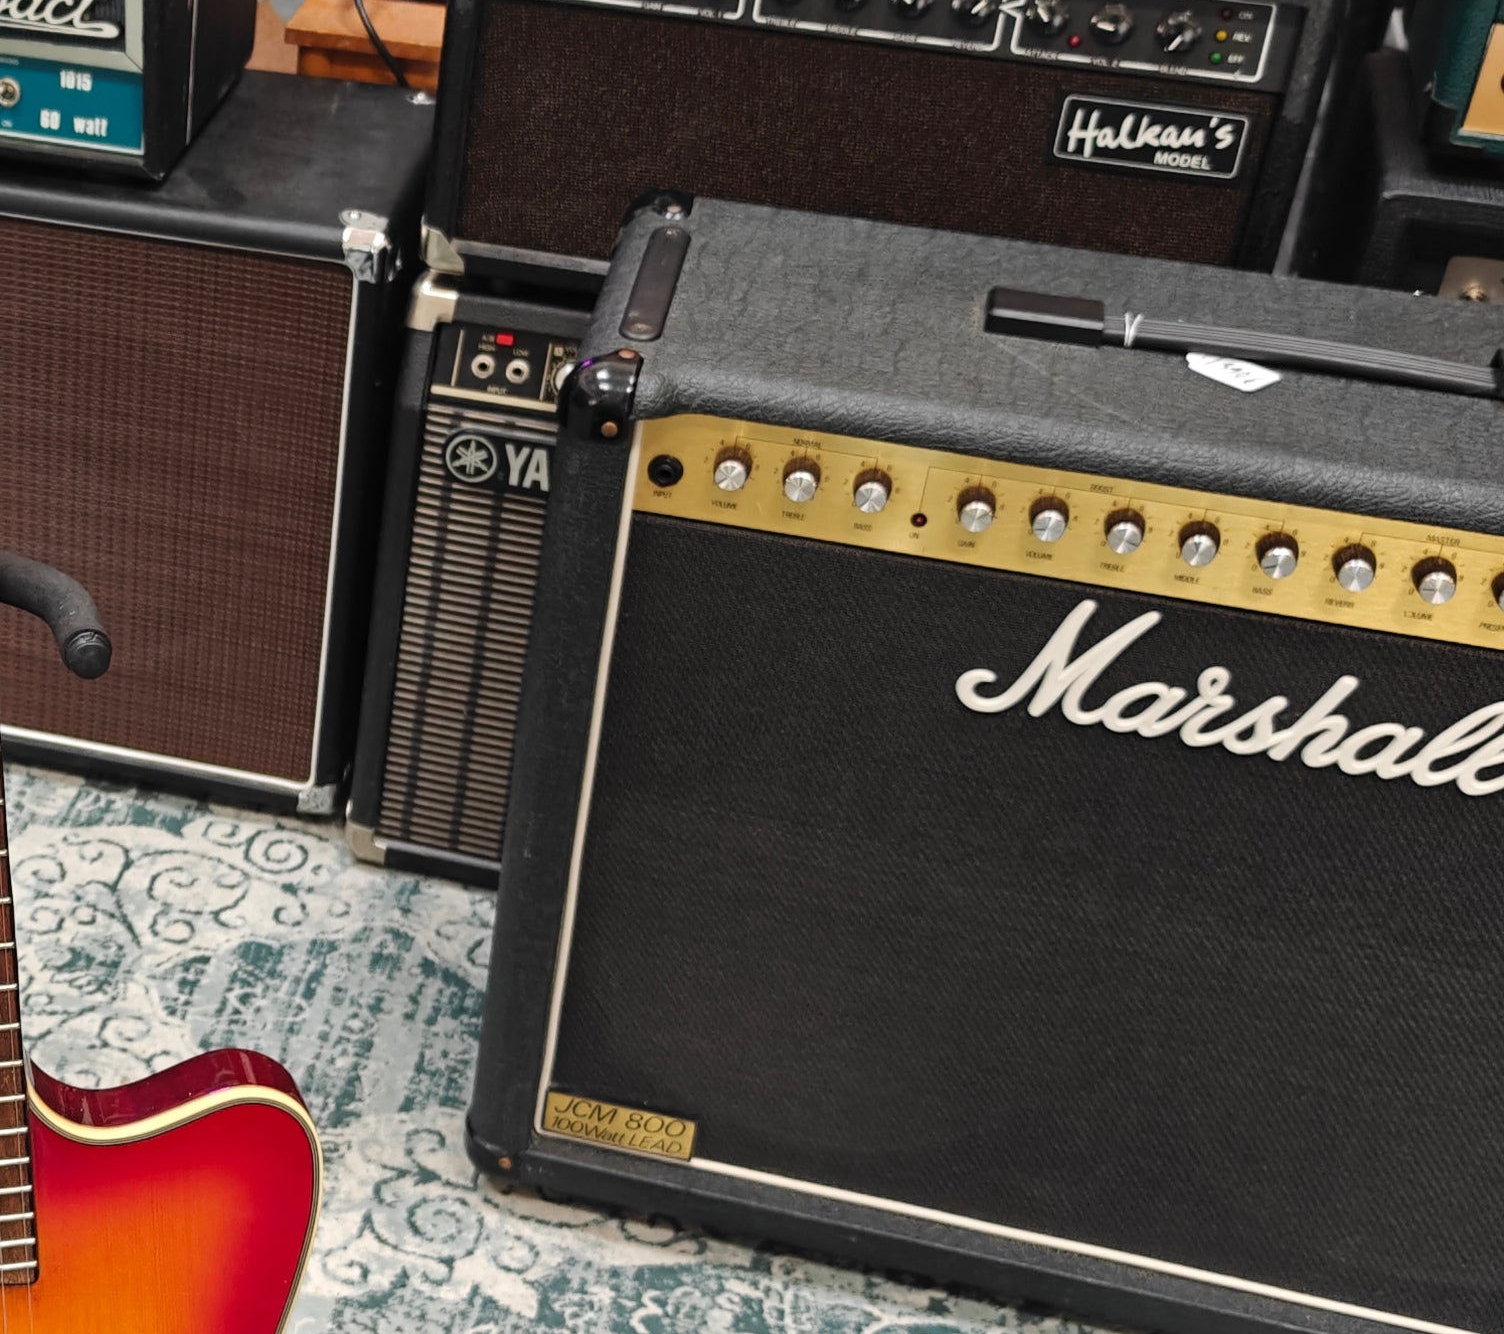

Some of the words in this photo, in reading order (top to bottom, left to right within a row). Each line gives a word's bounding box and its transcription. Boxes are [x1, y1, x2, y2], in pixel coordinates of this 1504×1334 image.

[1025, 48, 1058, 61] ATTACK
[1159, 63, 1188, 76] BLEND
[59, 69, 93, 92] 1015
[39, 108, 61, 130] 60
[73, 116, 109, 138] watt
[1066, 107, 1238, 159] Halkan's
[1153, 150, 1212, 171] MODEL
[512, 347, 530, 357] LOW
[711, 499, 737, 511] VOLUME
[1425, 533, 1462, 546] MASTER
[1025, 551, 1054, 562] VOLUME
[1251, 586, 1273, 597] BASS
[1324, 597, 1356, 609] REVERB
[955, 598, 1504, 797] Marshall
[553, 1097, 619, 1125] JCM
[624, 1111, 687, 1139] 800
[551, 1115, 626, 1145] 100Watt
[627, 1134, 684, 1156] LEAD
